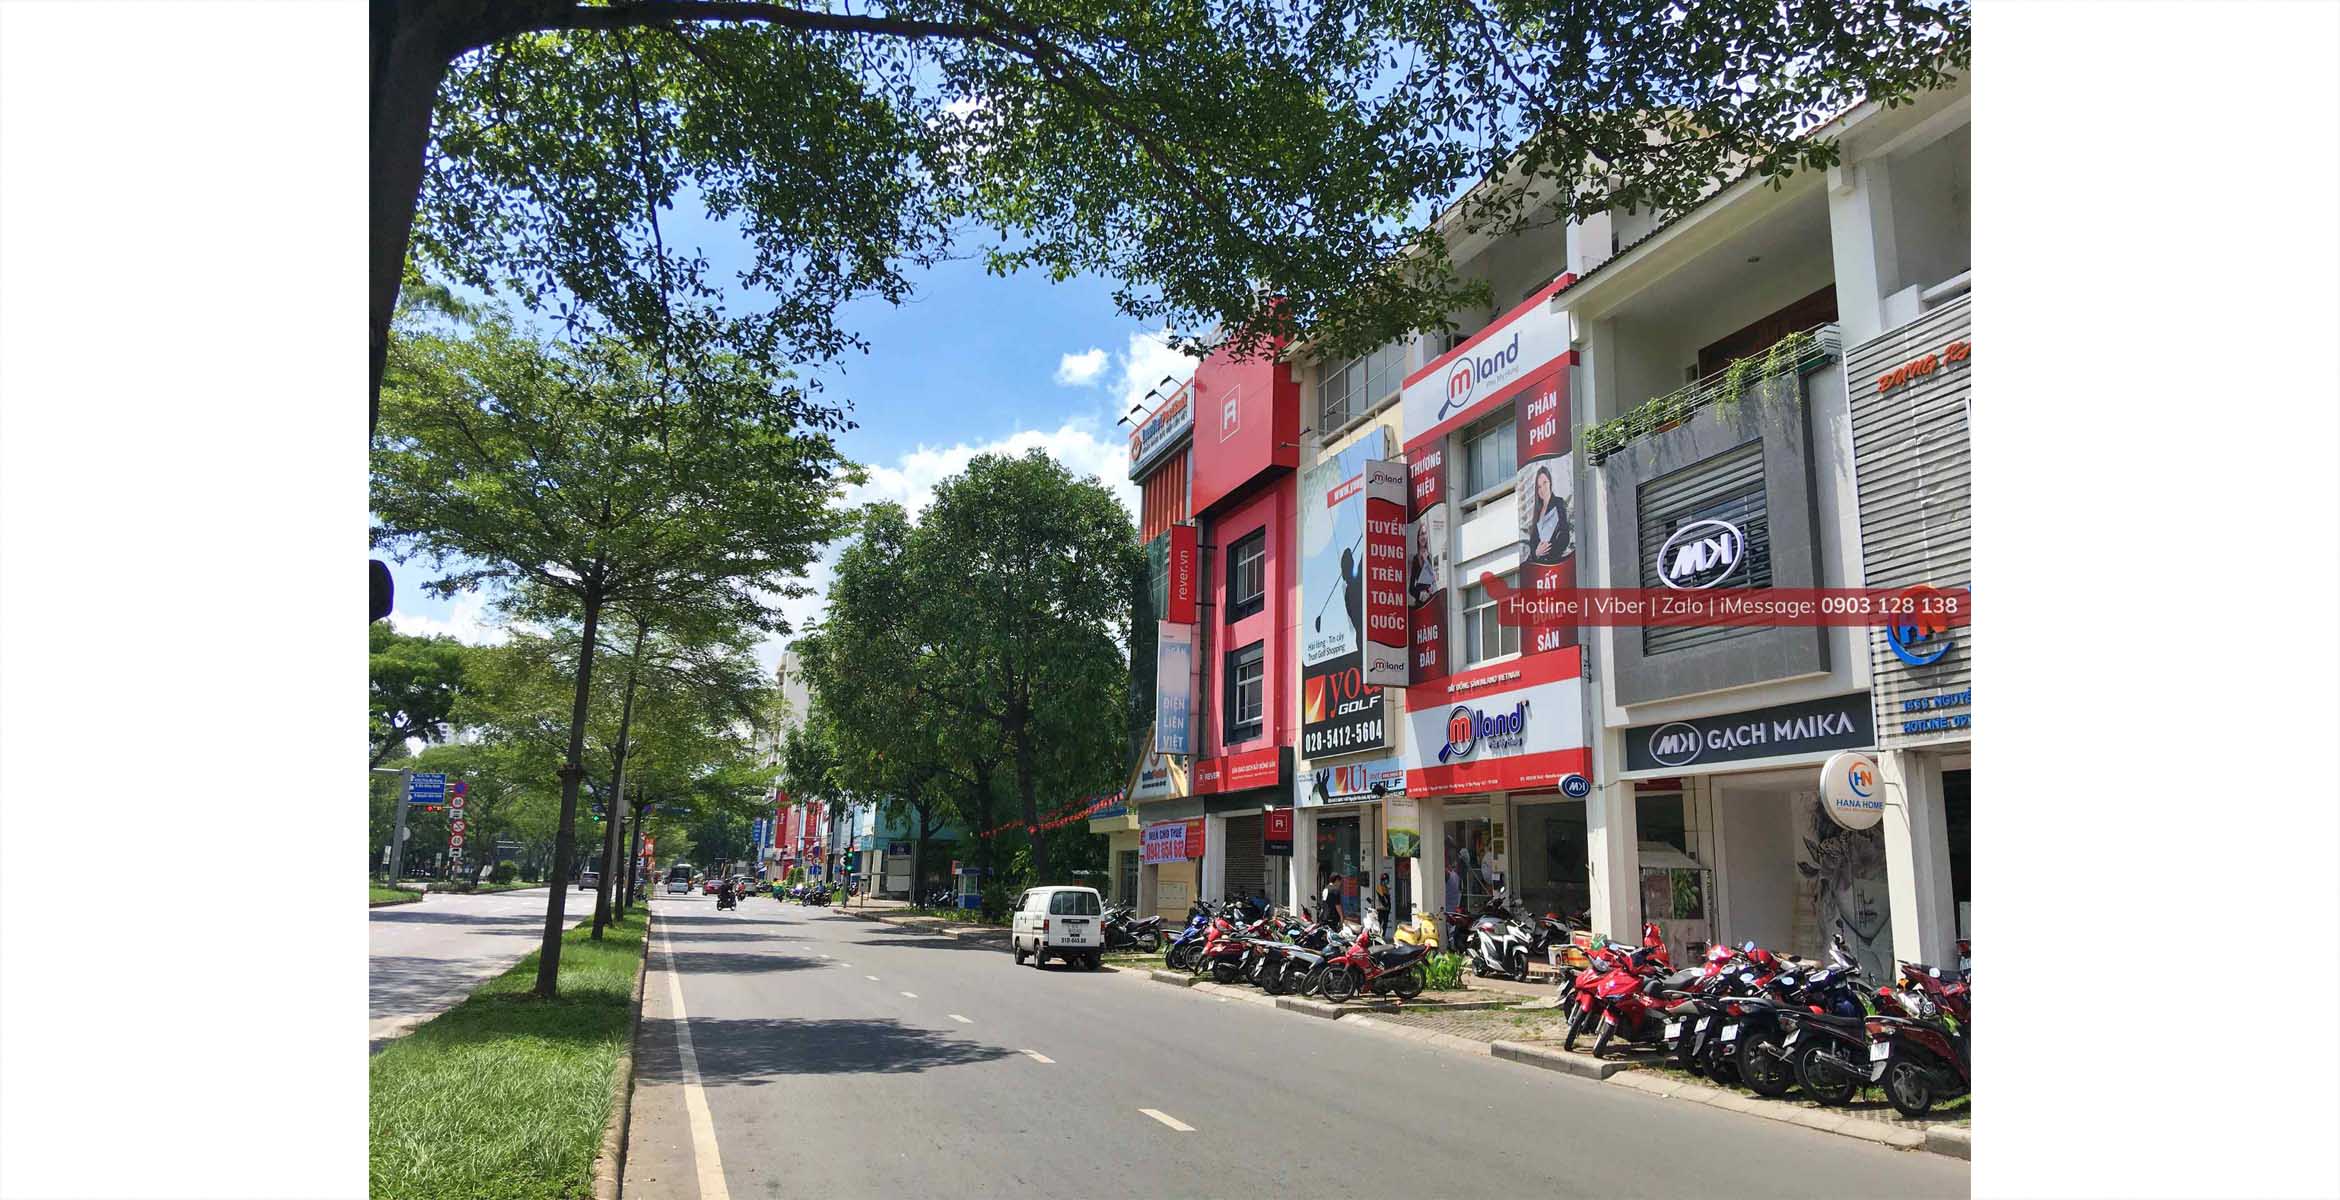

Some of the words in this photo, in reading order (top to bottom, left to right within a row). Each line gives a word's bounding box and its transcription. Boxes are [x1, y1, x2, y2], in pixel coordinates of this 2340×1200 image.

[1527, 391, 1557, 420] PHÂN
[1529, 415, 1556, 445] PHỐI
[1410, 450, 1441, 478] THƯƠNG
[1416, 477, 1435, 499] HIỆU
[1368, 517, 1406, 537] TUYỂN
[1371, 544, 1404, 560] DỤNG
[1178, 550, 1188, 600] rever.vn
[1372, 566, 1403, 582] TRÊN
[1371, 589, 1403, 606] TOÀN
[1371, 612, 1405, 630] QUỐC
[1417, 624, 1439, 644] HÀNG
[1537, 626, 1559, 651] SẢN
[1420, 647, 1436, 668] ĐẦU
[1338, 695, 1382, 715] GOLF
[1163, 715, 1185, 729] LIÊN
[1450, 701, 1523, 744] mland
[1707, 722, 1767, 751] GẠCH
[1773, 711, 1856, 742] MAIKA
[1163, 734, 1185, 749] VIỆT
[1305, 719, 1382, 752] 028-5412-5604
[1854, 770, 1873, 787] HN
[1836, 799, 1861, 808] HANA
[1862, 801, 1883, 809] HOME
